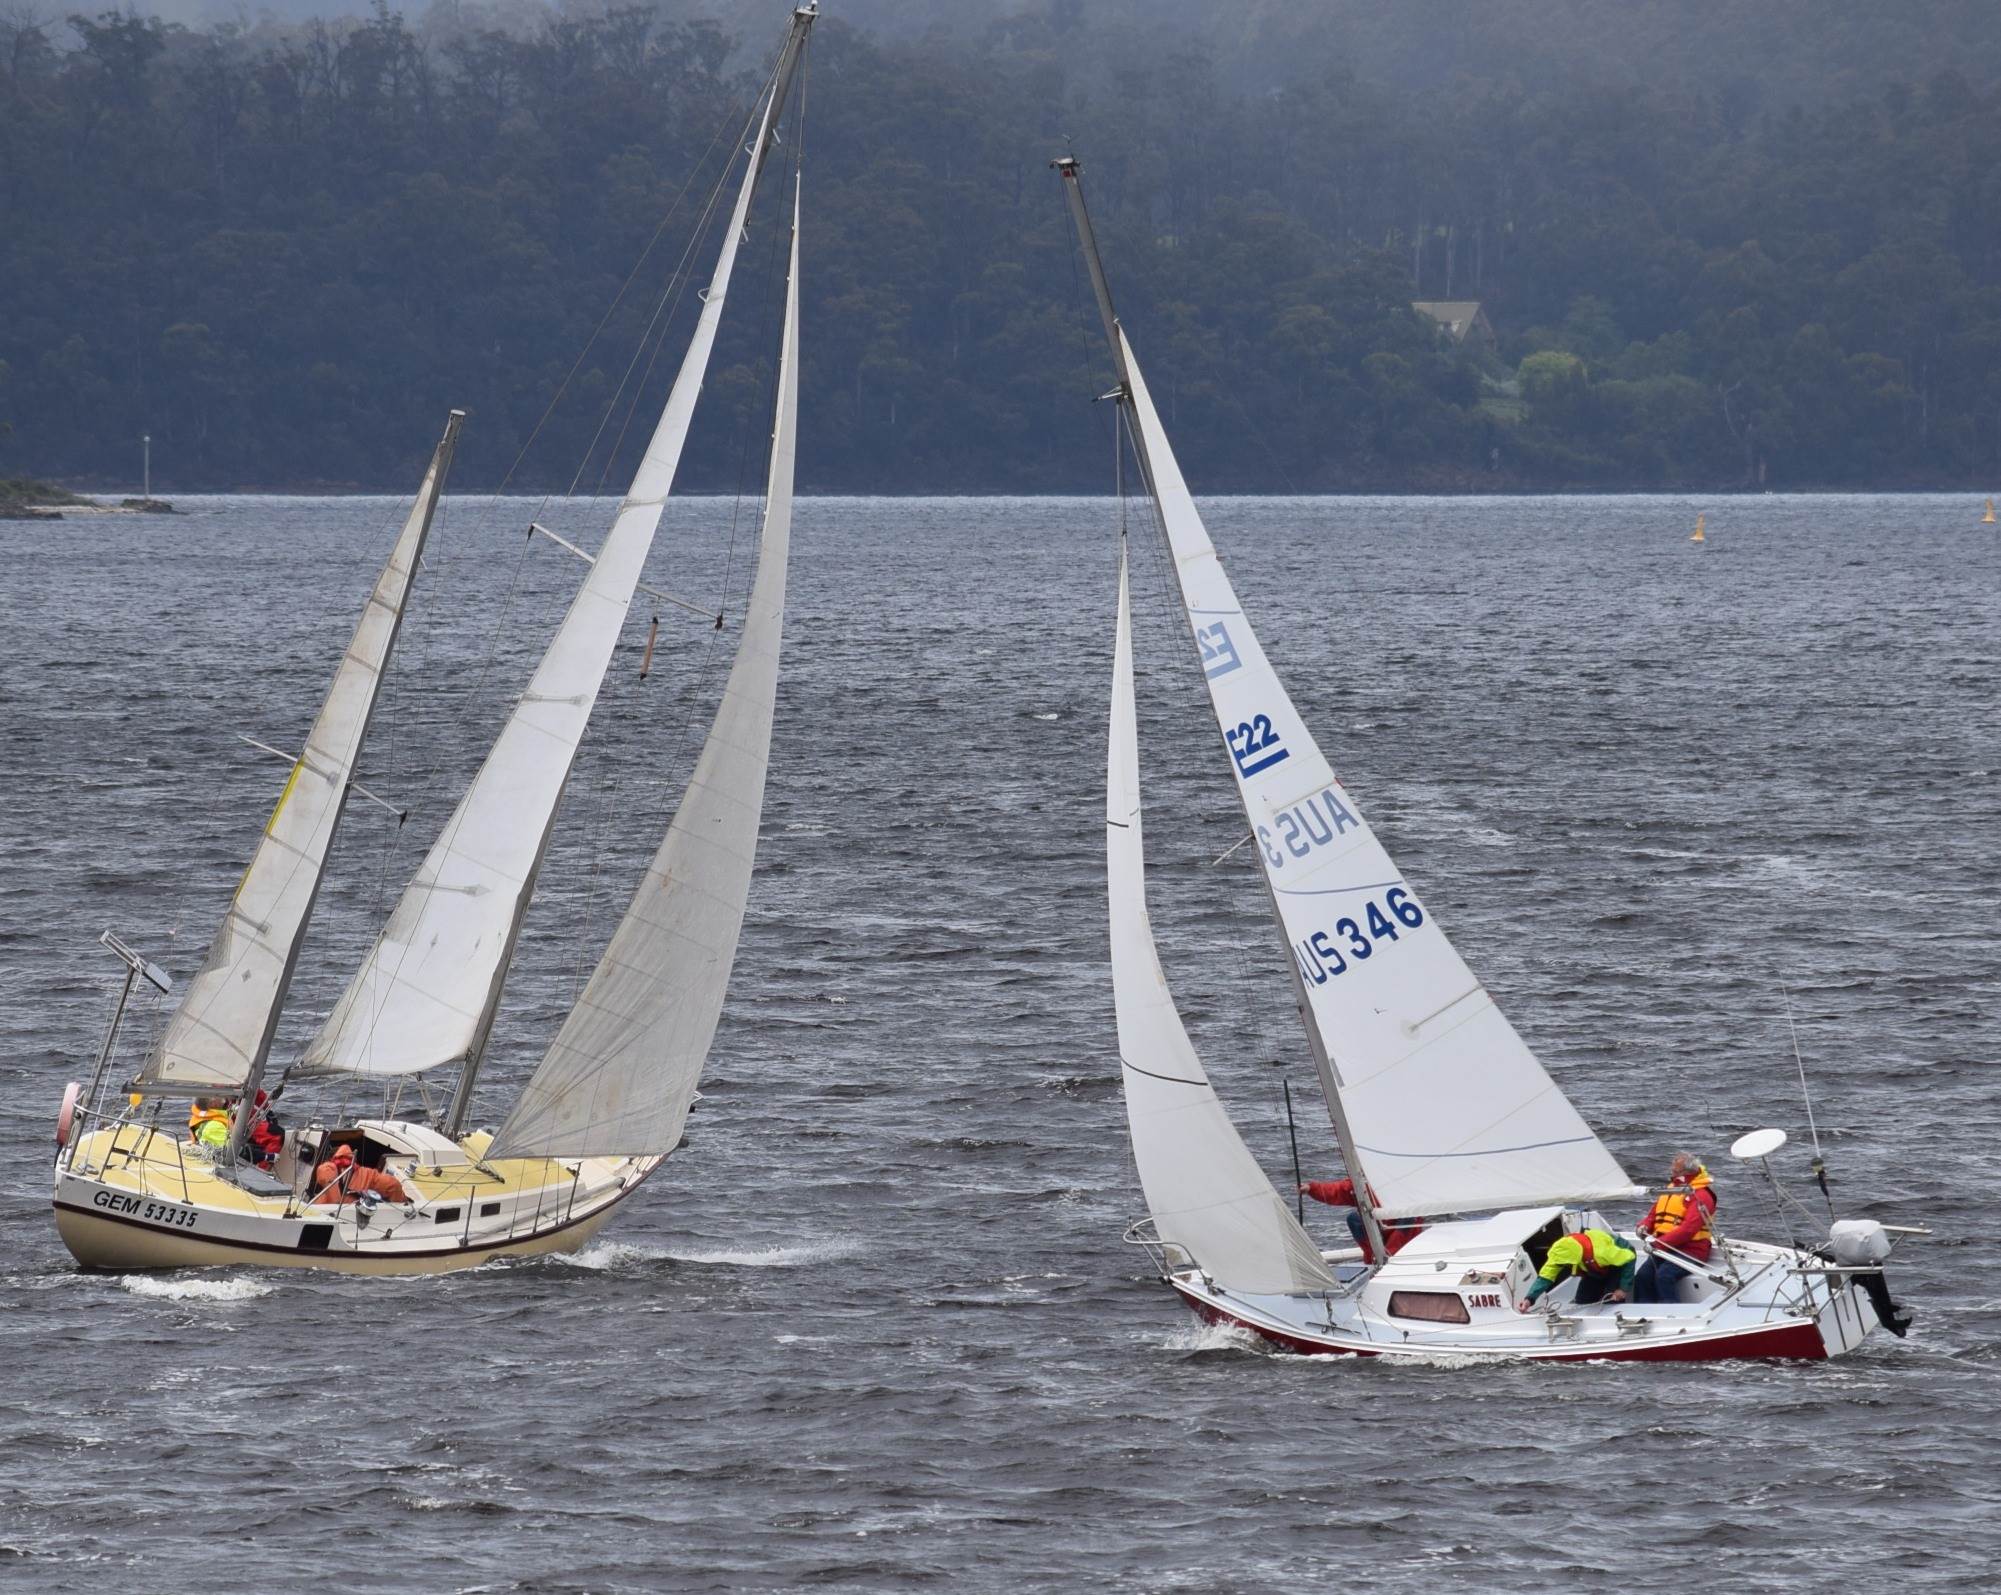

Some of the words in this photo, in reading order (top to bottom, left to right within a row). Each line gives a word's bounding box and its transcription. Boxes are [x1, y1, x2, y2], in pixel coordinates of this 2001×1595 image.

[1225, 714, 1290, 779] E22
[93, 1190, 141, 1214] GEM
[144, 1203, 198, 1227] 53335
[1468, 1294, 1502, 1308] SABRE
